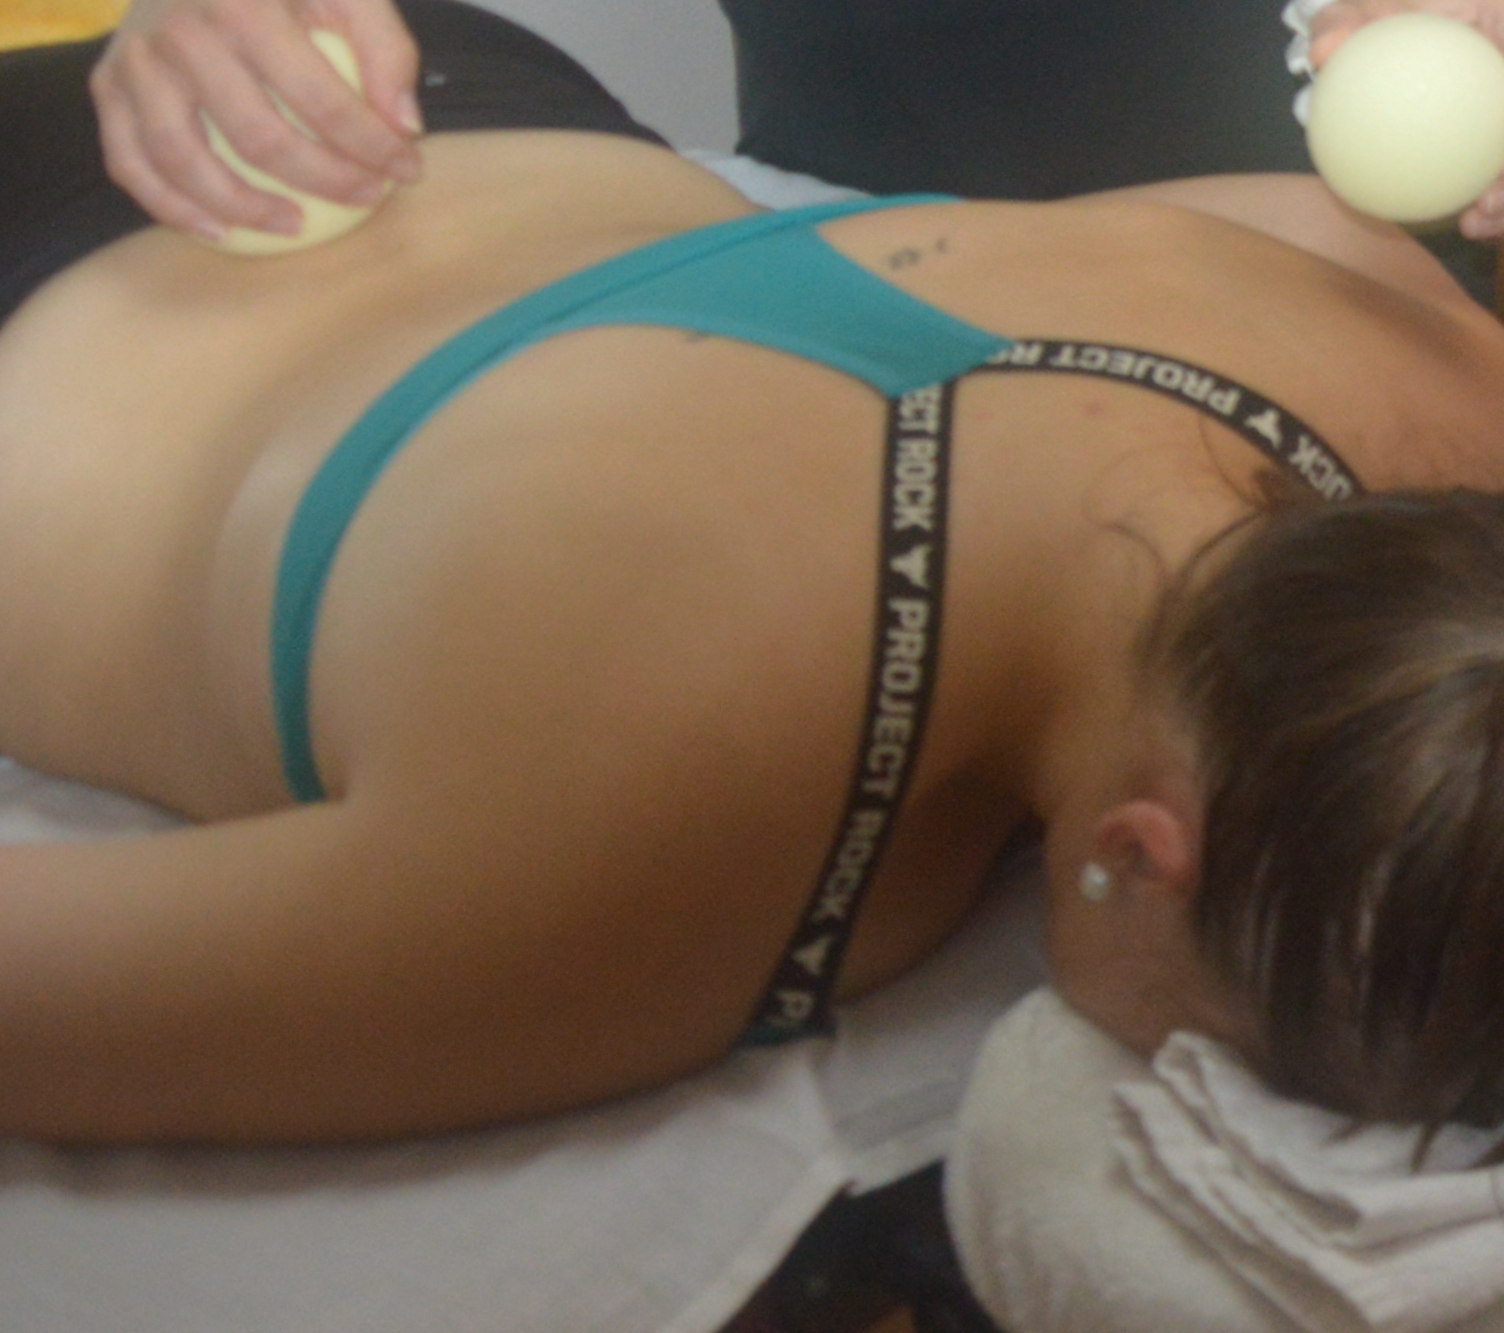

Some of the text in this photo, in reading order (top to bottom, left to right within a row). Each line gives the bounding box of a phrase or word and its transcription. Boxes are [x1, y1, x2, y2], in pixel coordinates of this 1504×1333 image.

[1048, 343, 1242, 417] PROJECT
[892, 437, 940, 532] ROCK
[861, 597, 931, 799] PROJECT
[811, 807, 887, 924] ROCK
